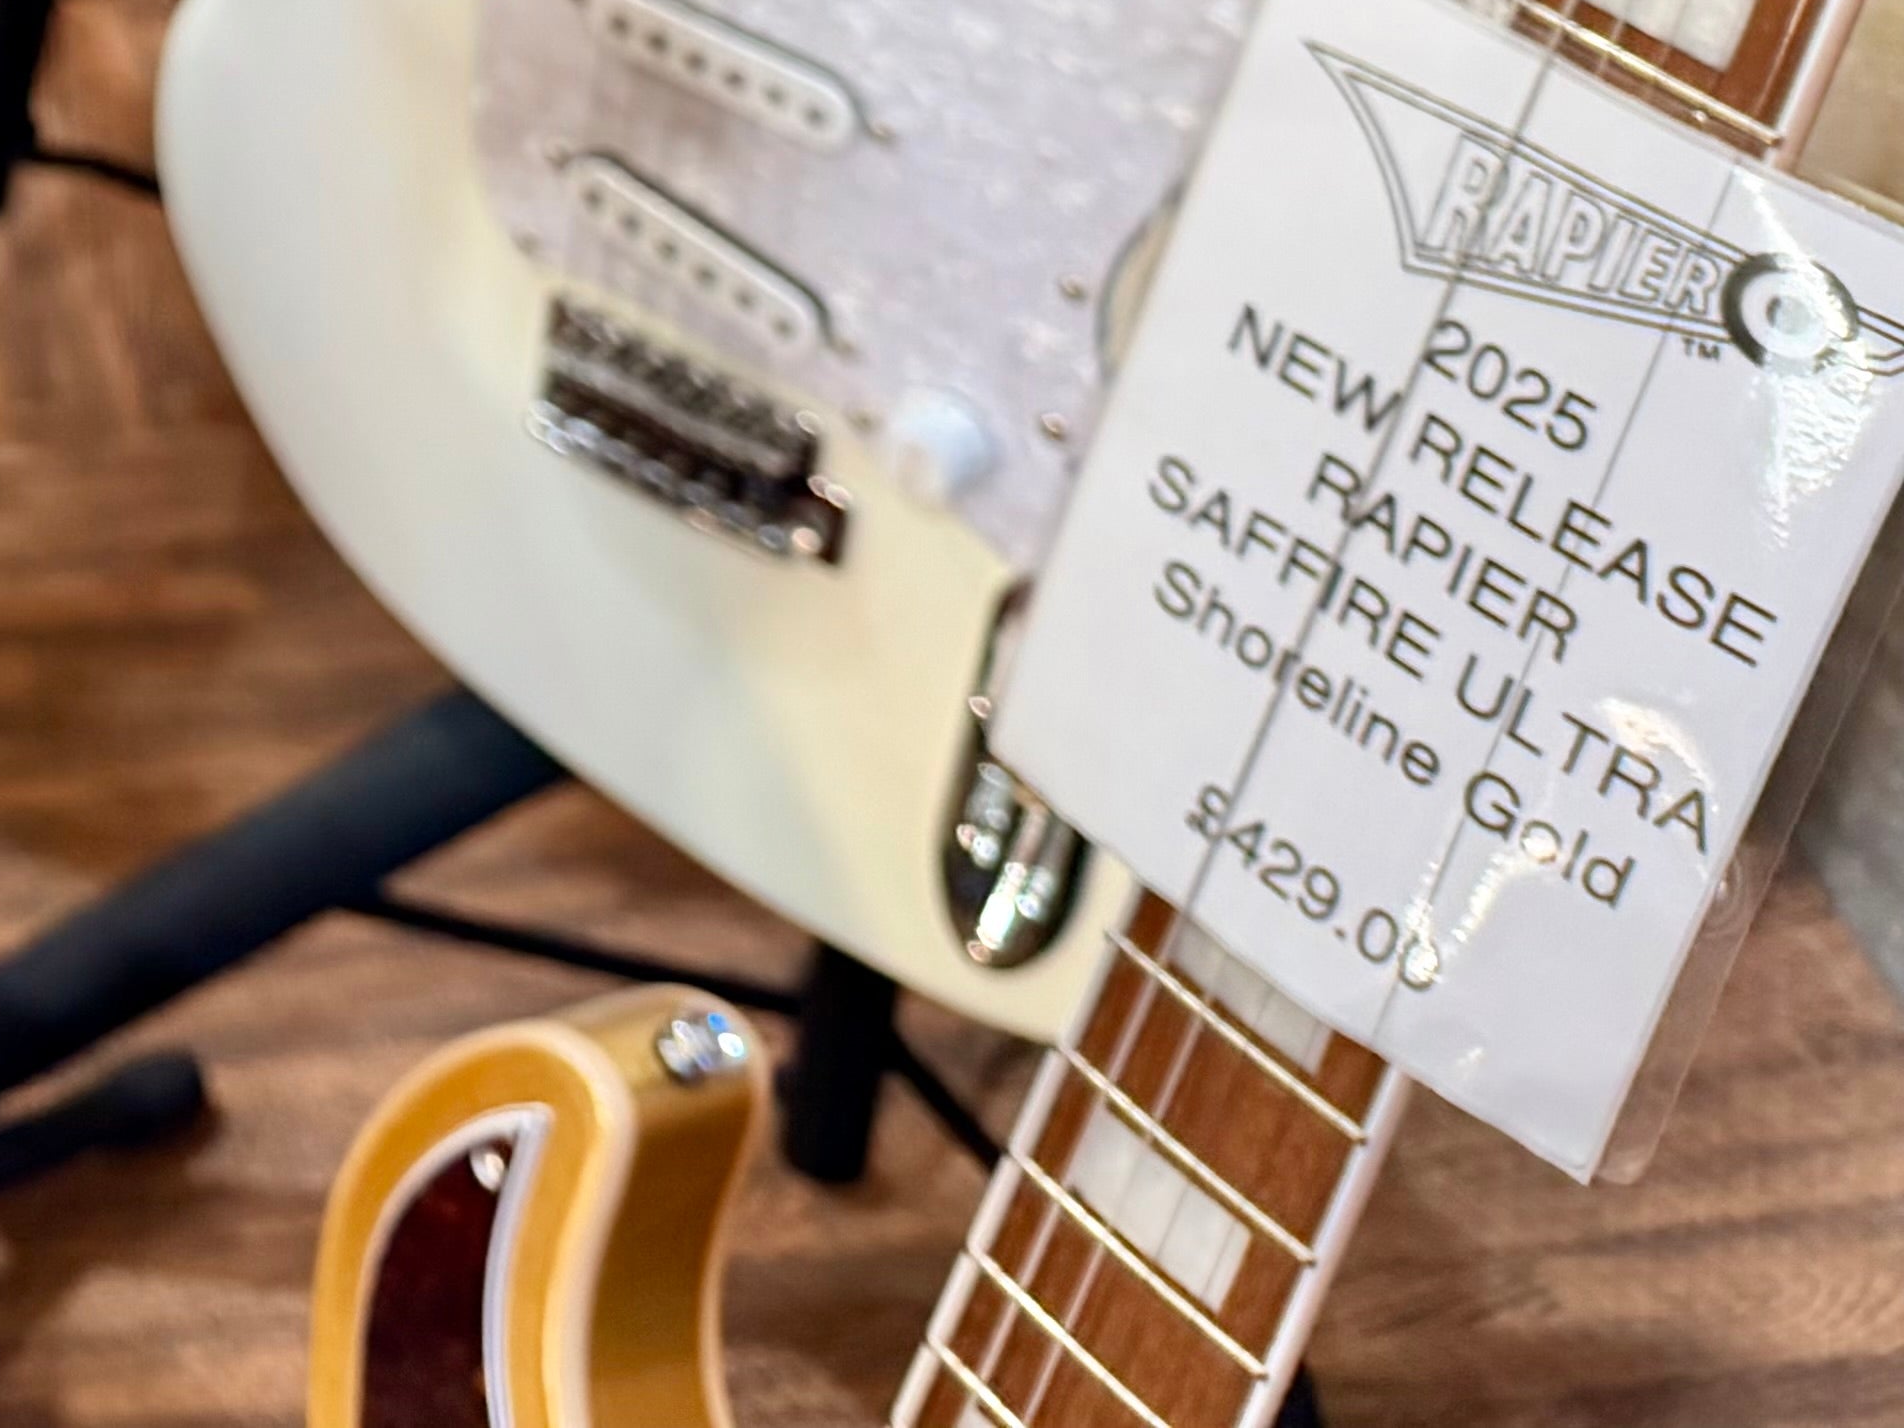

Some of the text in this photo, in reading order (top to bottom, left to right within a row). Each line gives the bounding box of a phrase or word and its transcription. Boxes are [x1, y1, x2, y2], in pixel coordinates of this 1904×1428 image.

[1419, 132, 1721, 317] RAPIER
[1227, 304, 1777, 668] NEW RELEASE
[1424, 319, 1597, 453] 2025
[1148, 455, 1712, 854] SAFFIRE ULTRA
[1307, 452, 1579, 662] RAPIER
[1153, 560, 1636, 909] Shoreline Gold
[1184, 784, 1440, 992] £429.00
